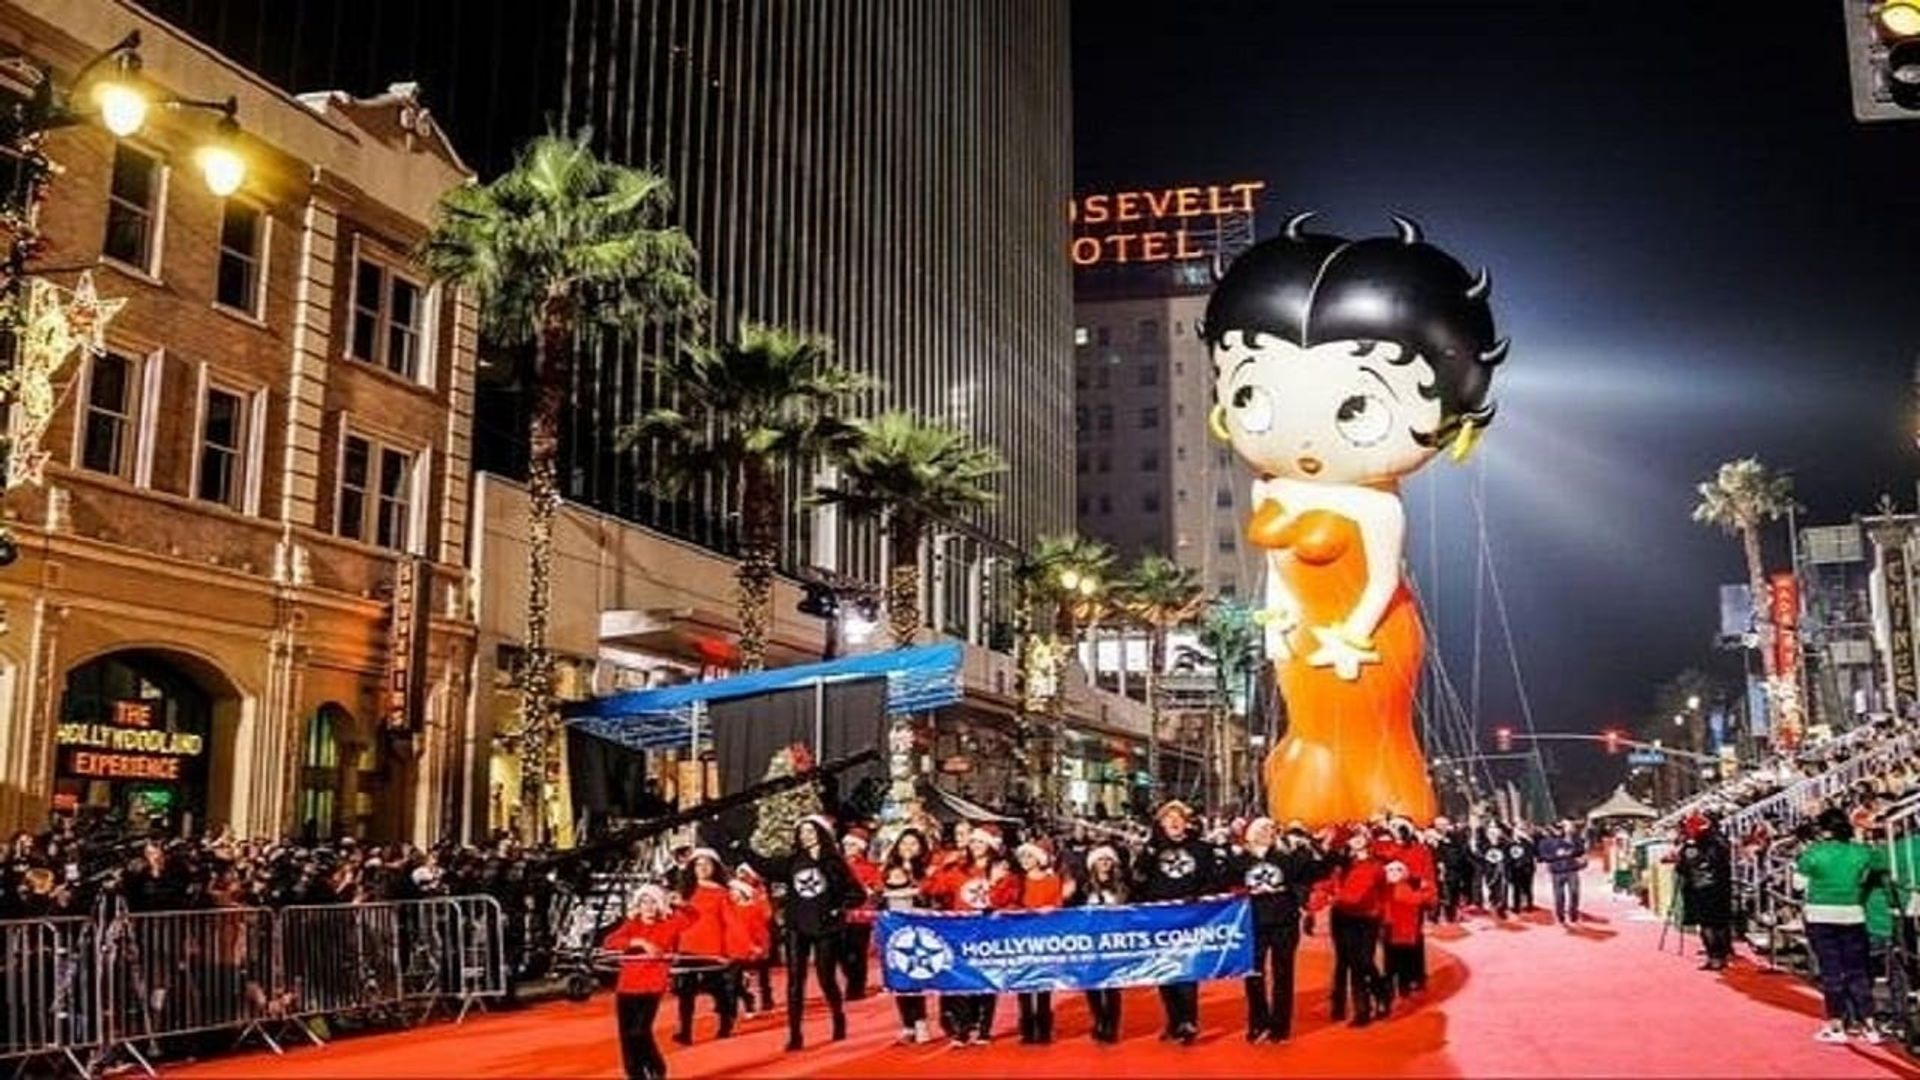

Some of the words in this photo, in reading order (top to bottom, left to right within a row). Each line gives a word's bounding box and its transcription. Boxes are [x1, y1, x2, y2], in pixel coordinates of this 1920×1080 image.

[1069, 181, 1264, 223] SEVELT
[116, 701, 151, 726] THE
[76, 753, 179, 779] EXPERIENCE
[961, 934, 1093, 957] HOLLYWOOD
[1098, 930, 1150, 950] ARTS
